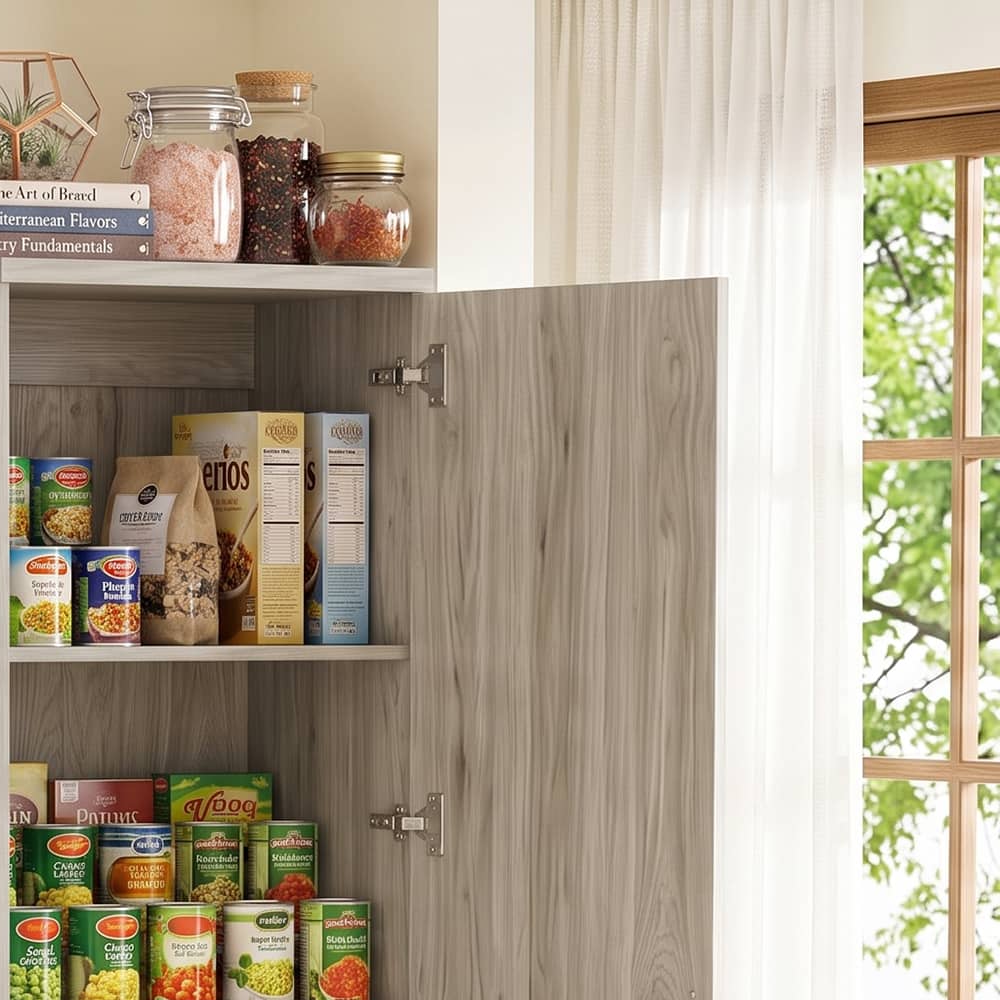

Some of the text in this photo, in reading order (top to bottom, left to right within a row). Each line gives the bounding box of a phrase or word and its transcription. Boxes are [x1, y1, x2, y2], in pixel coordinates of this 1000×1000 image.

[15, 186, 37, 200] Art
[42, 187, 56, 201] of
[70, 213, 118, 229] Flavors
[21, 238, 113, 253] Fundamentals
